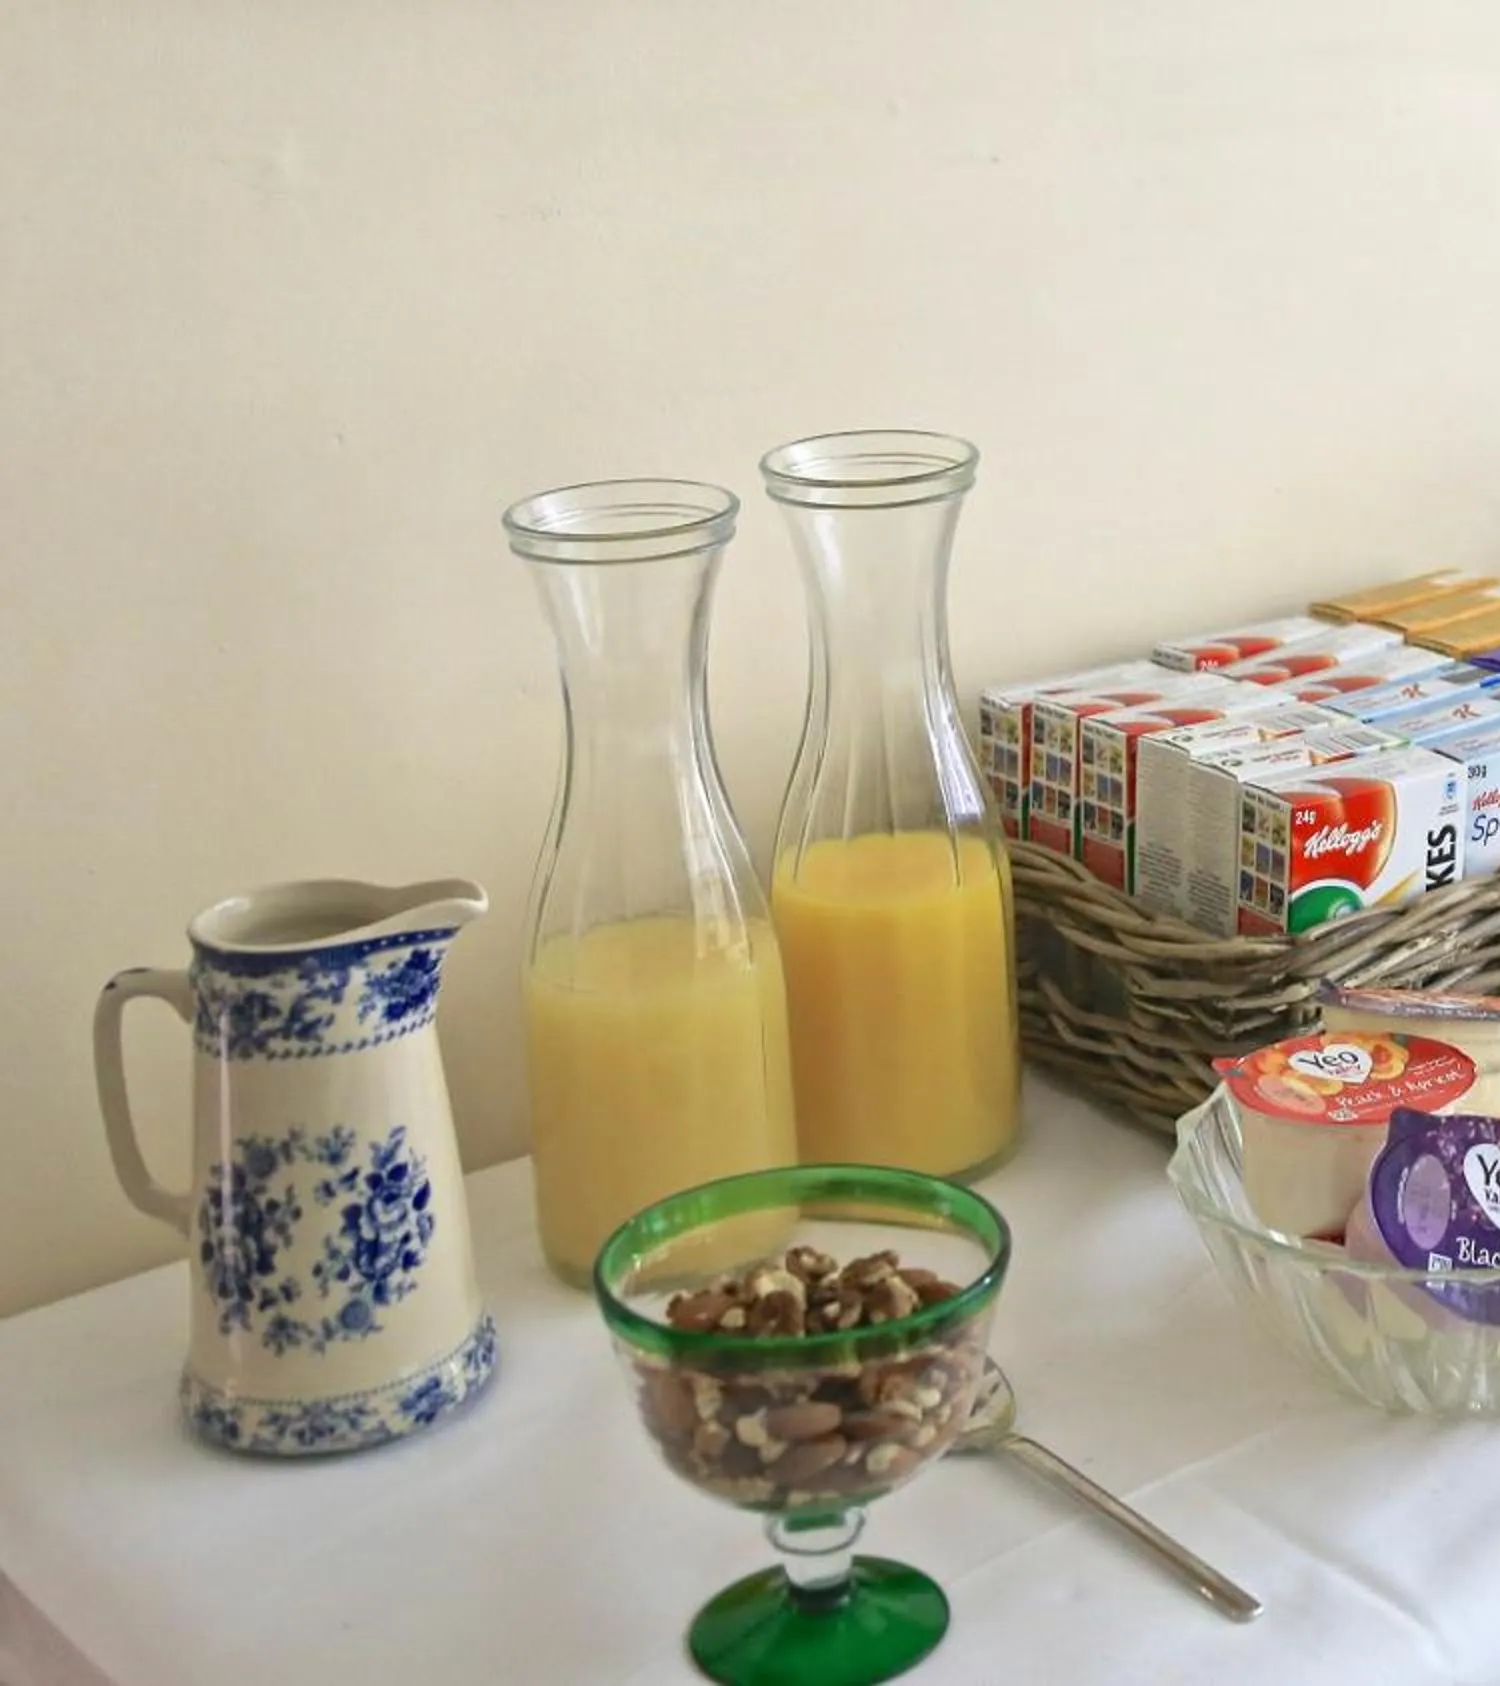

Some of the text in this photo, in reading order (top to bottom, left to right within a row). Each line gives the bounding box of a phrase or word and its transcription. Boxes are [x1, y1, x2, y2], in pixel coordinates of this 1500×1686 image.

[1295, 811, 1317, 825] 24g
[1304, 819, 1383, 858] Kellogg's
[1298, 1050, 1361, 1072] Yeo
